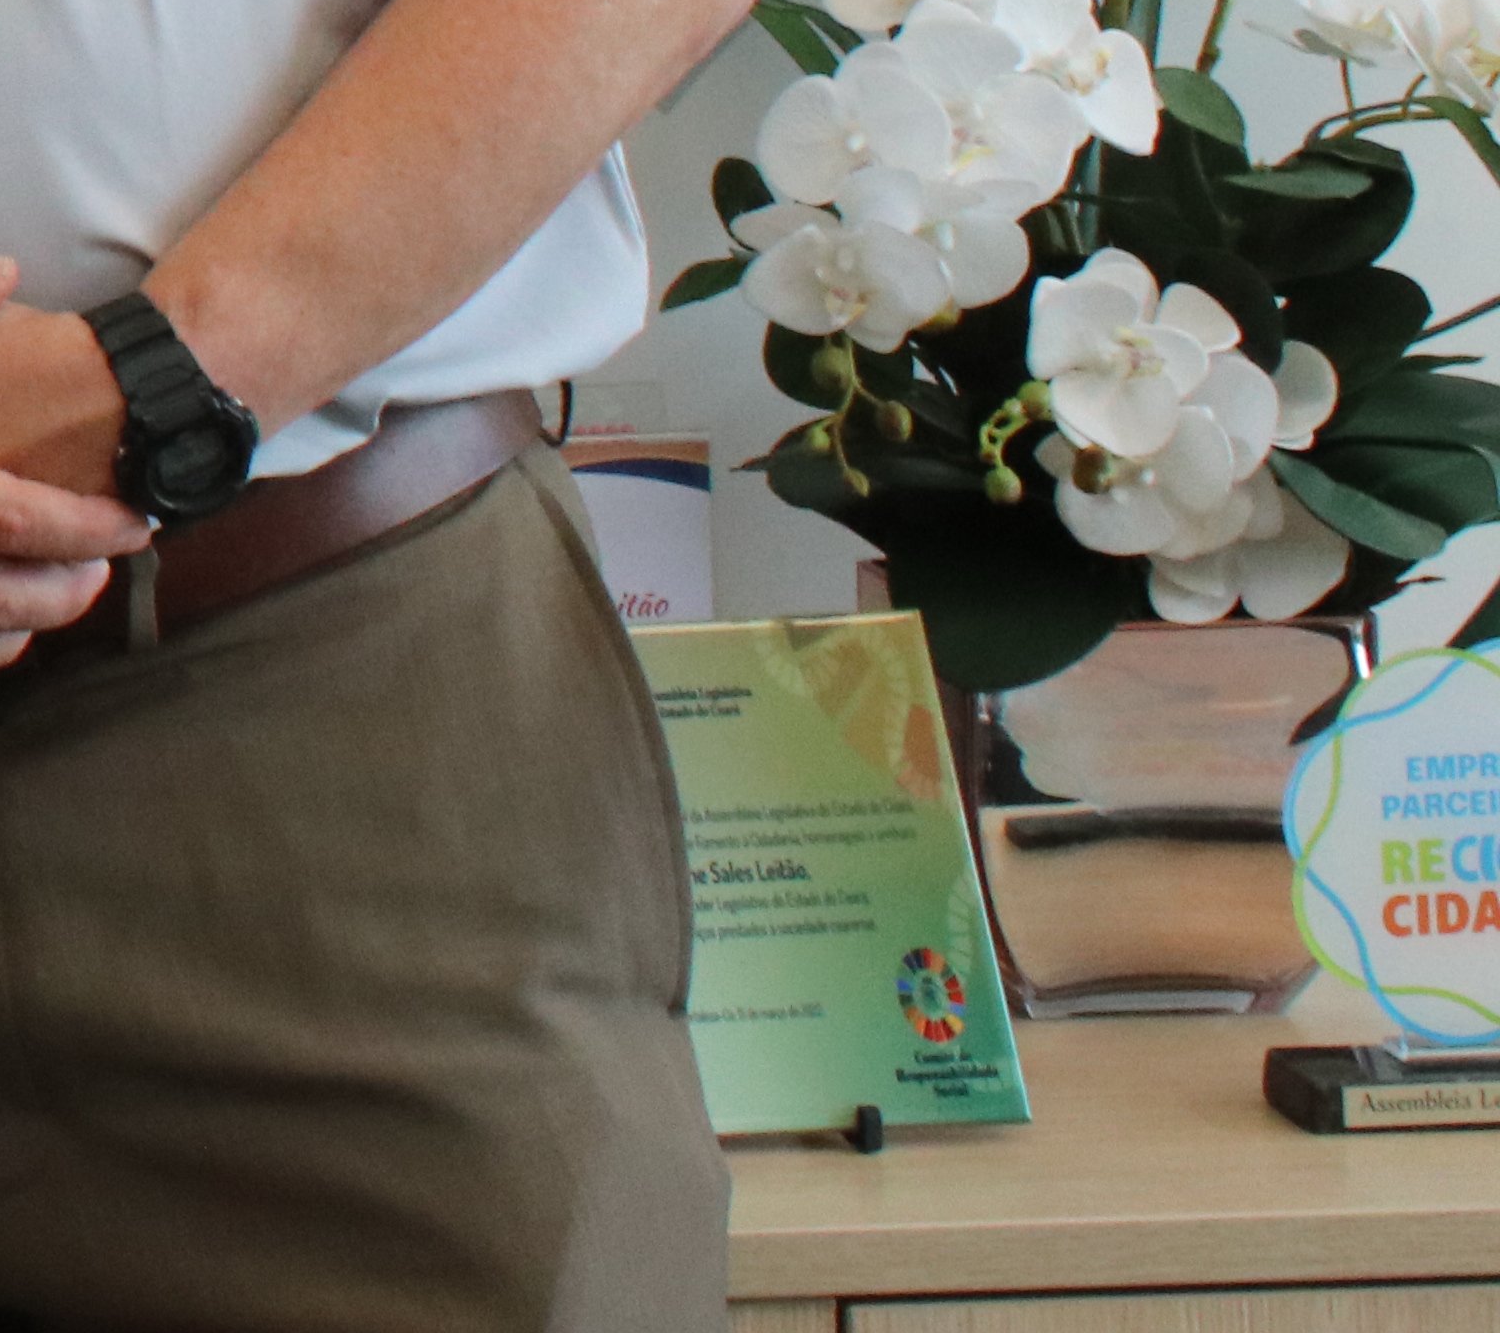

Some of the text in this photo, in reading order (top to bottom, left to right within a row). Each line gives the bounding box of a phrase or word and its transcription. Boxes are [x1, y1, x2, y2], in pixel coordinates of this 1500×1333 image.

[1380, 833, 1500, 884] RECI
[708, 860, 754, 884] Sales
[1360, 1089, 1472, 1113] Assembleia
